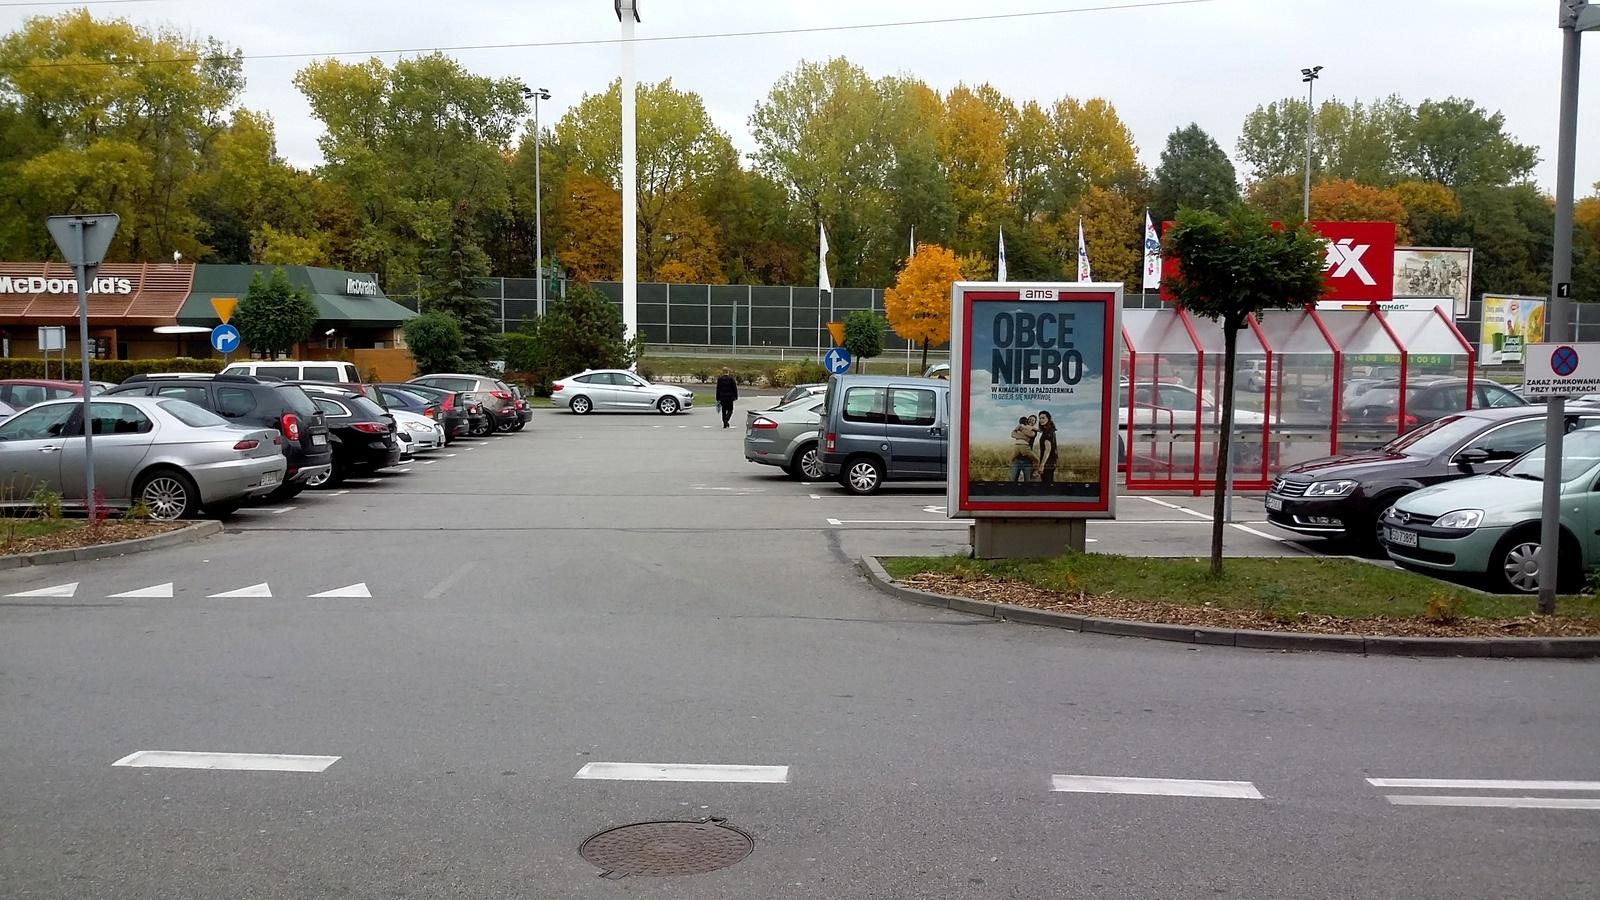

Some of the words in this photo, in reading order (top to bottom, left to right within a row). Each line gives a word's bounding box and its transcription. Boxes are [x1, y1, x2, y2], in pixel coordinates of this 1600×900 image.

[0, 277, 132, 294] McDonld's
[1561, 284, 1568, 297] 1
[1025, 289, 1053, 299] ams
[993, 312, 1076, 349] OBCE
[991, 349, 1083, 385] NIEBO
[1024, 394, 1051, 402] NAPRAWDĘ
